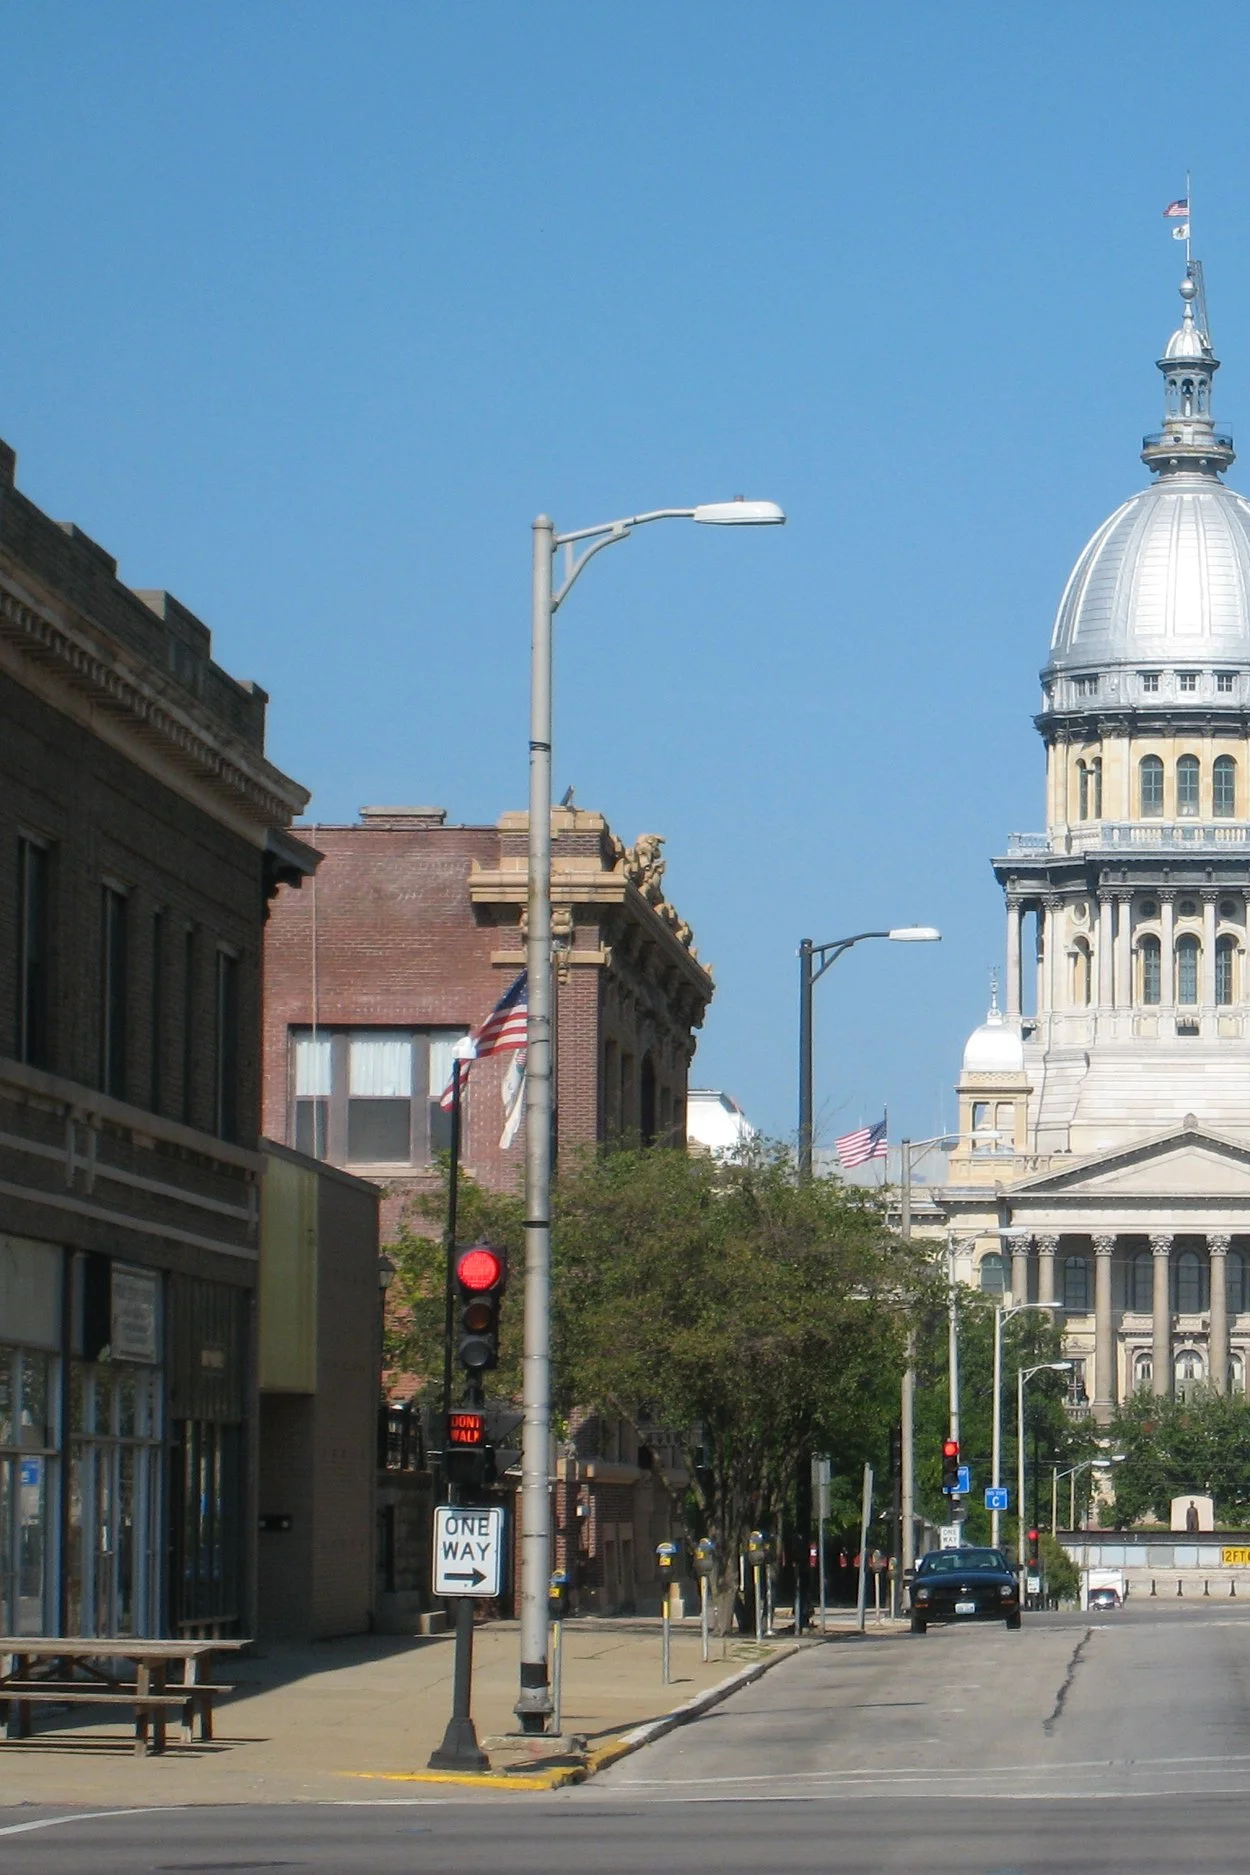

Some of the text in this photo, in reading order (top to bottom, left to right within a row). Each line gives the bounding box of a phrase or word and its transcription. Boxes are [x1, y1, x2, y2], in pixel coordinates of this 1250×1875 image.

[451, 1415, 480, 1428] DONT
[992, 1496, 1000, 1507] C
[445, 1516, 490, 1536] ONE
[942, 1528, 957, 1536] ONE
[442, 1541, 491, 1561] WAY
